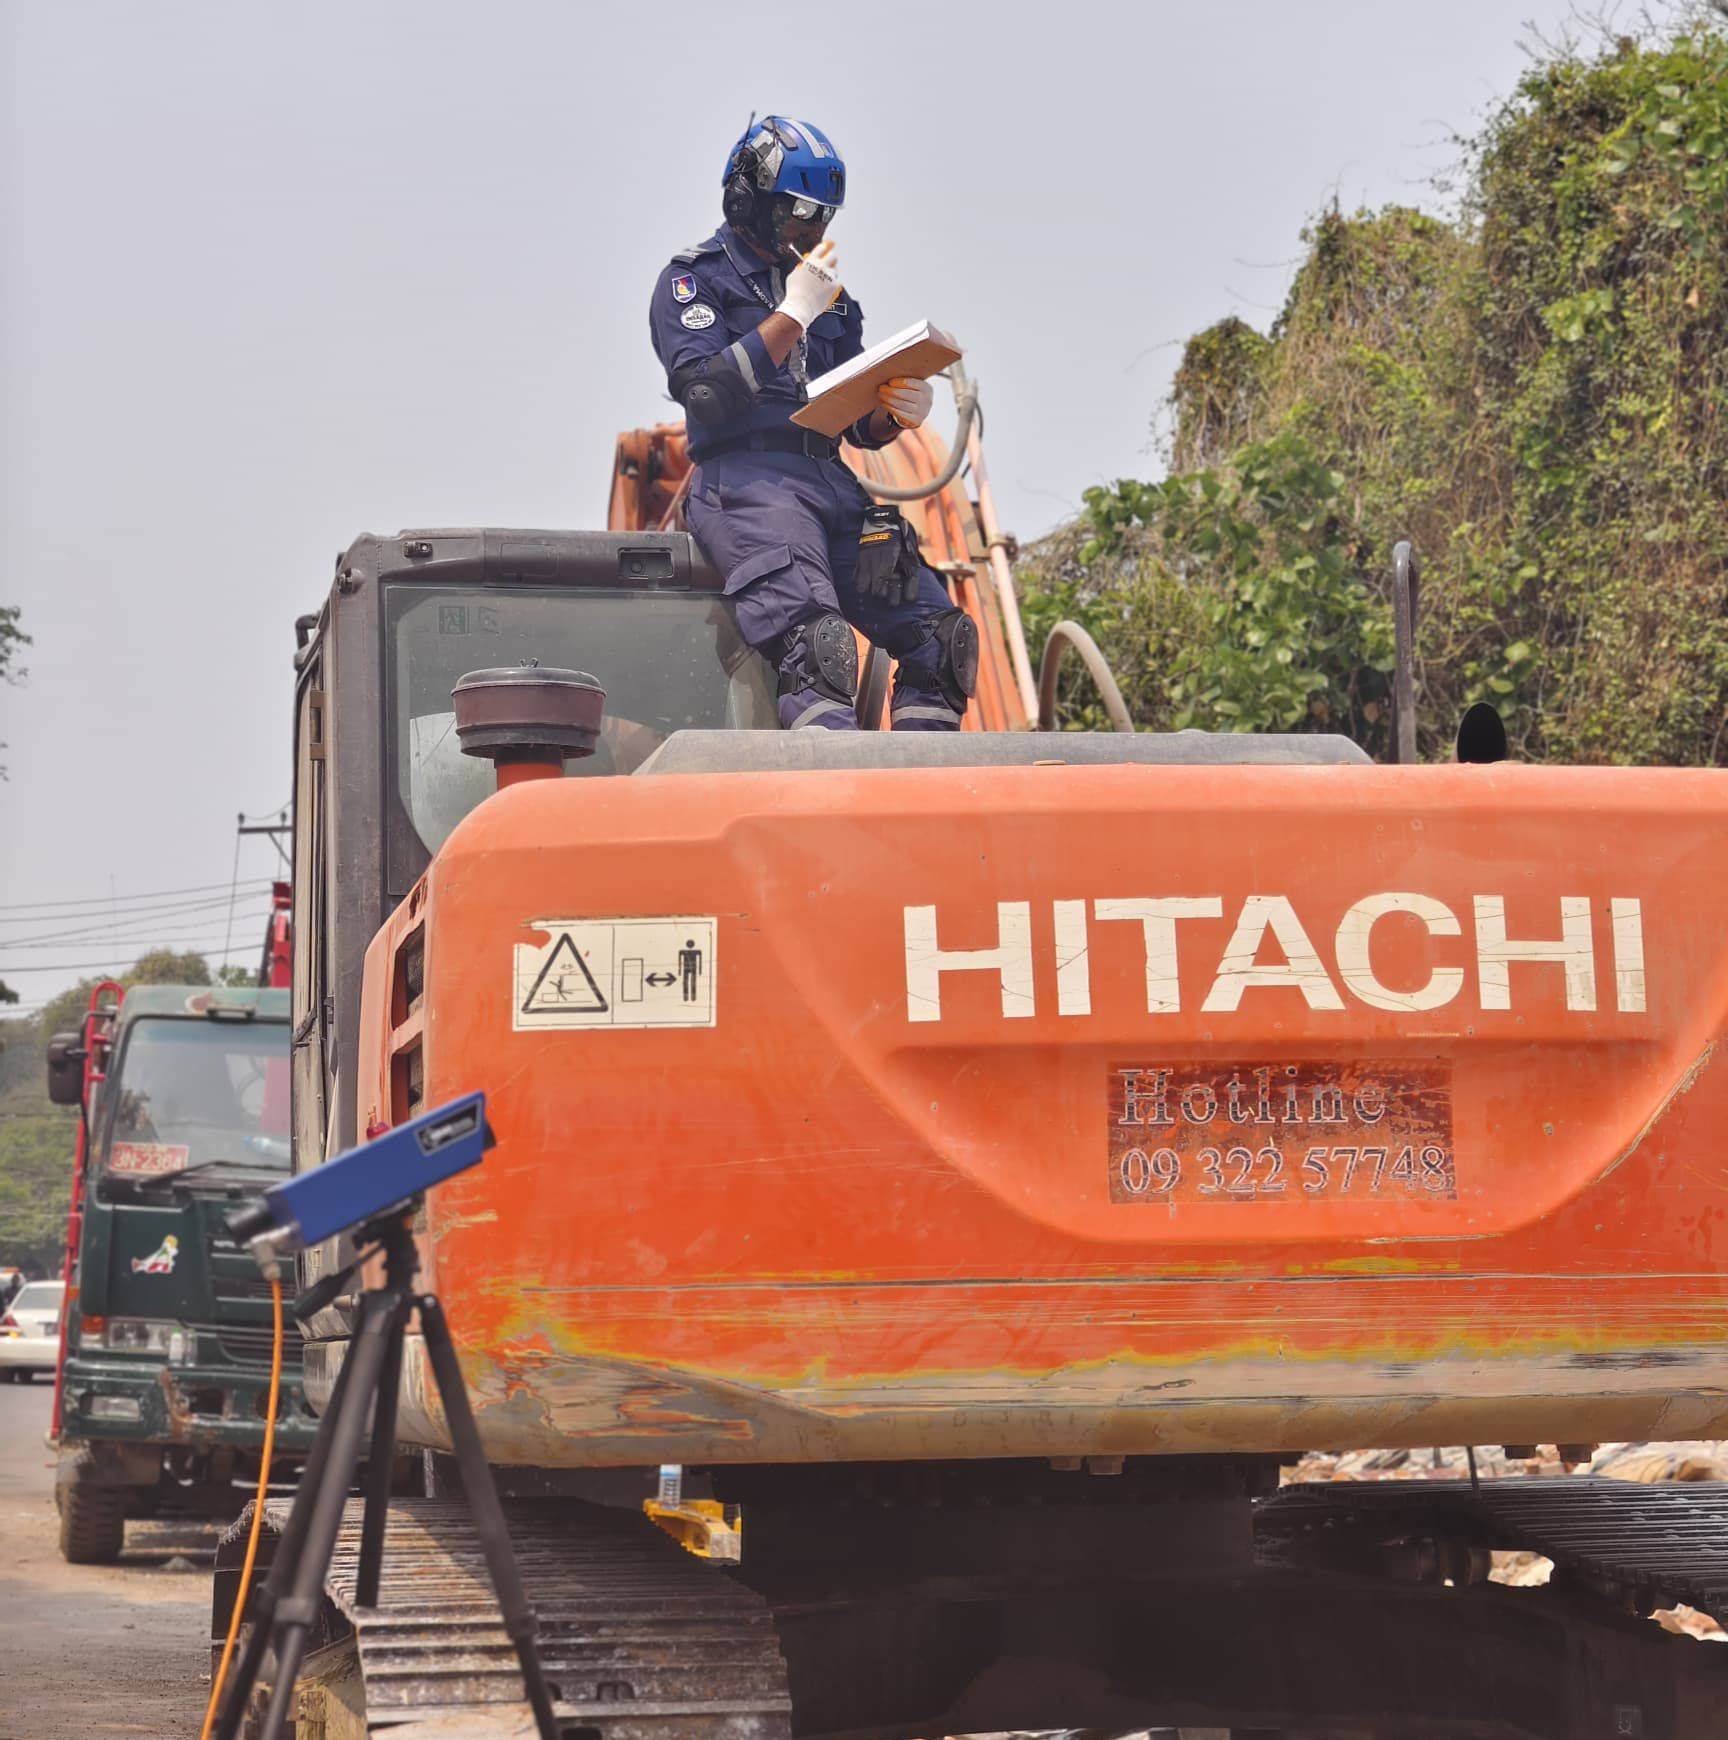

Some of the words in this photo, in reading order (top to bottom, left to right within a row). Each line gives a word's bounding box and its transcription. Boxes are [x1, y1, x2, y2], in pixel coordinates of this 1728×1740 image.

[904, 892, 1647, 1022] HITACHI
[1118, 1066, 1386, 1124] Hotline
[1120, 1147, 1181, 1193] 09
[1196, 1147, 1288, 1193] 322
[1302, 1146, 1447, 1193] 57748
